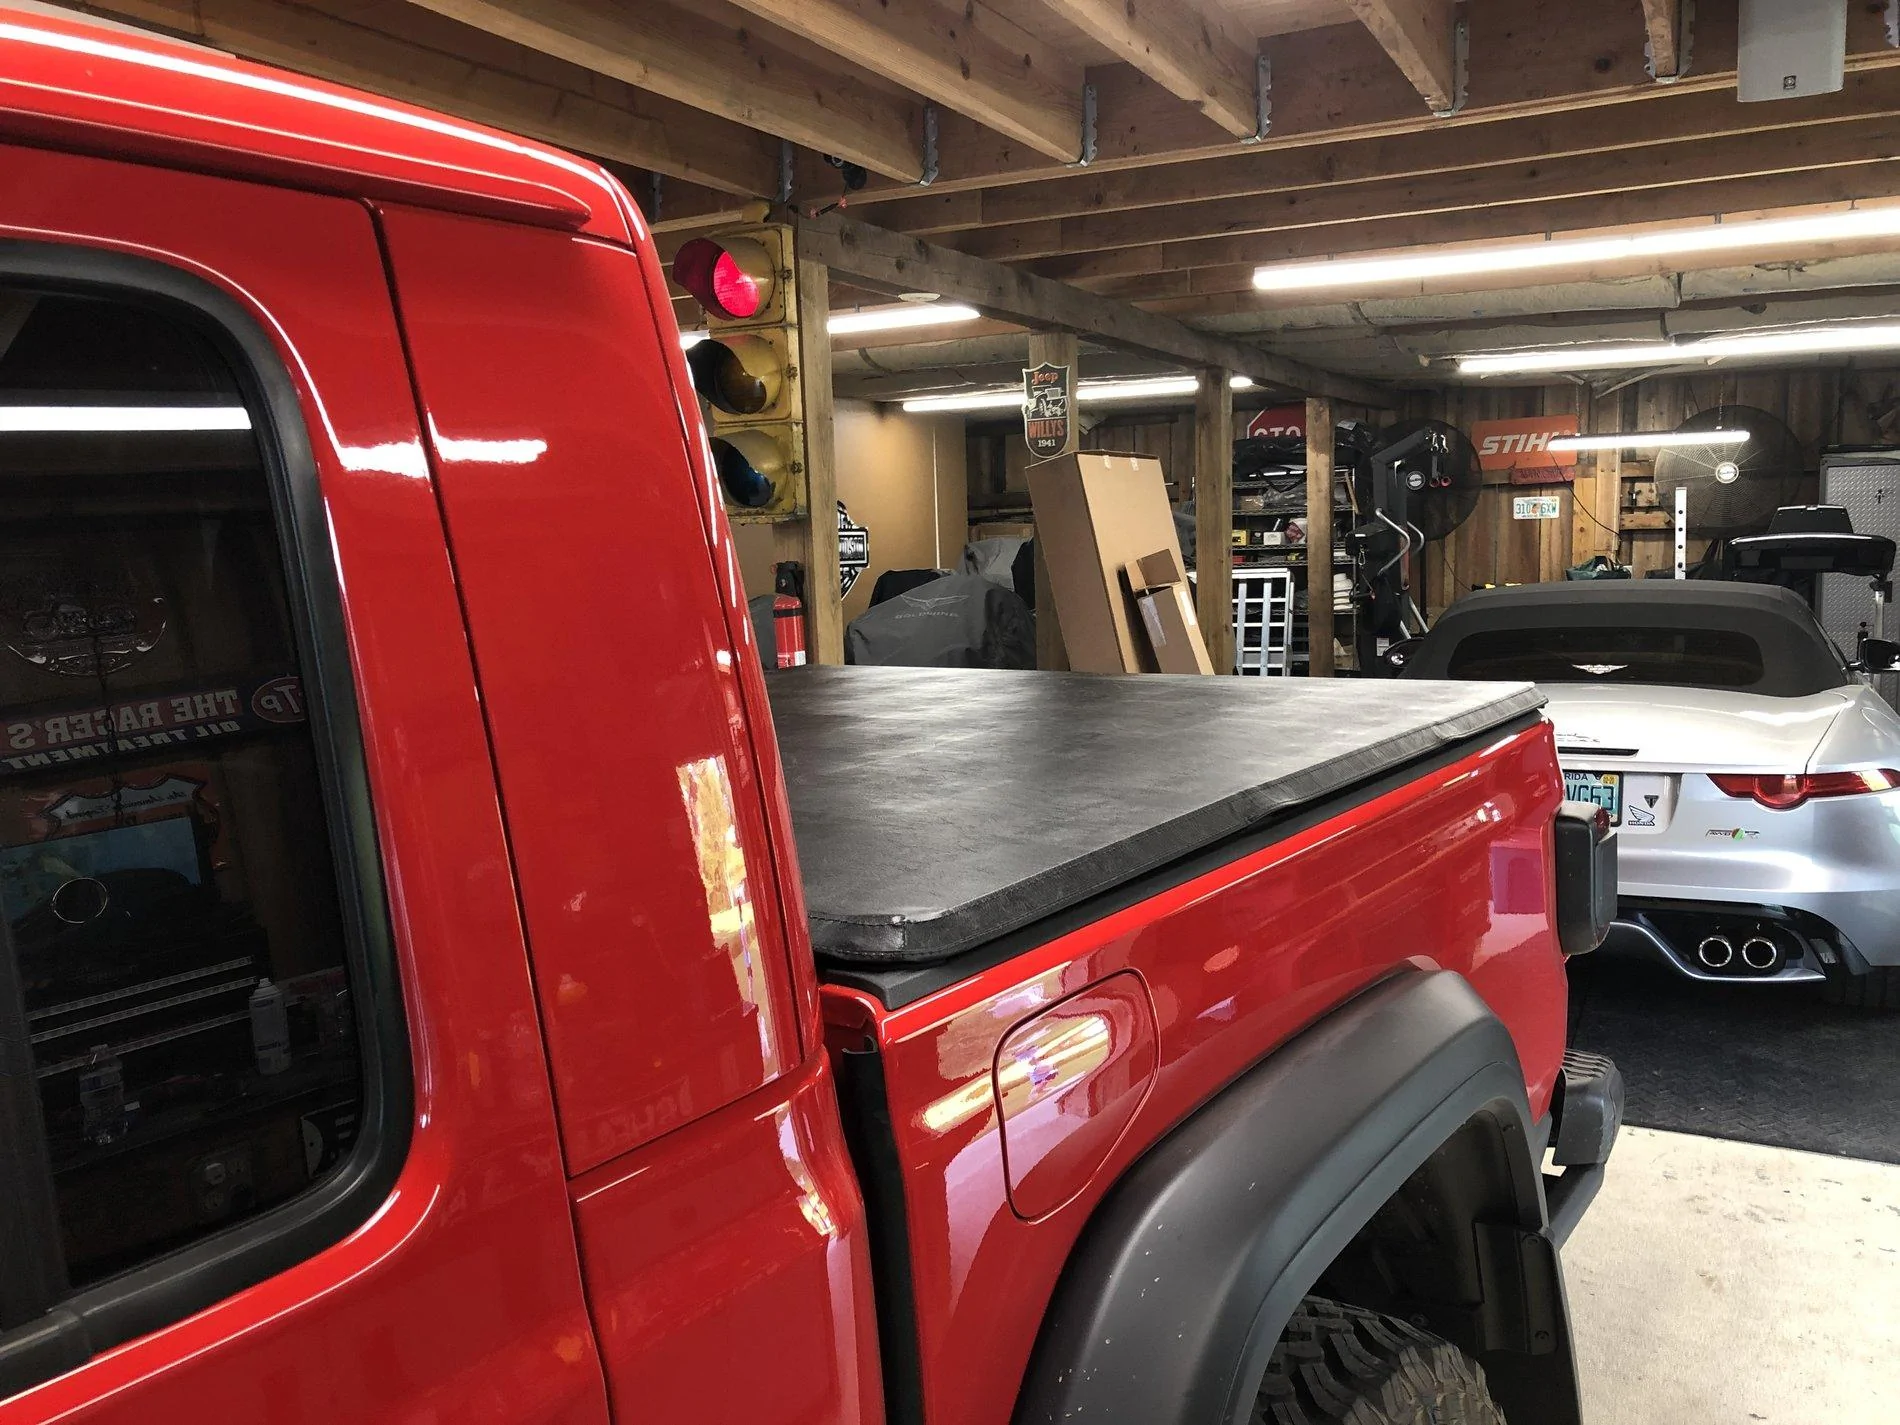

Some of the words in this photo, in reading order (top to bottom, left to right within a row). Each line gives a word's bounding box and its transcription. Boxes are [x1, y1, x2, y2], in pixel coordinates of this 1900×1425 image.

[1031, 371, 1059, 386] Jeep
[1028, 419, 1064, 439] WILLYS
[1037, 439, 1056, 448] 1941
[1478, 431, 1556, 456] STIH
[1564, 784, 1615, 811] VG63
